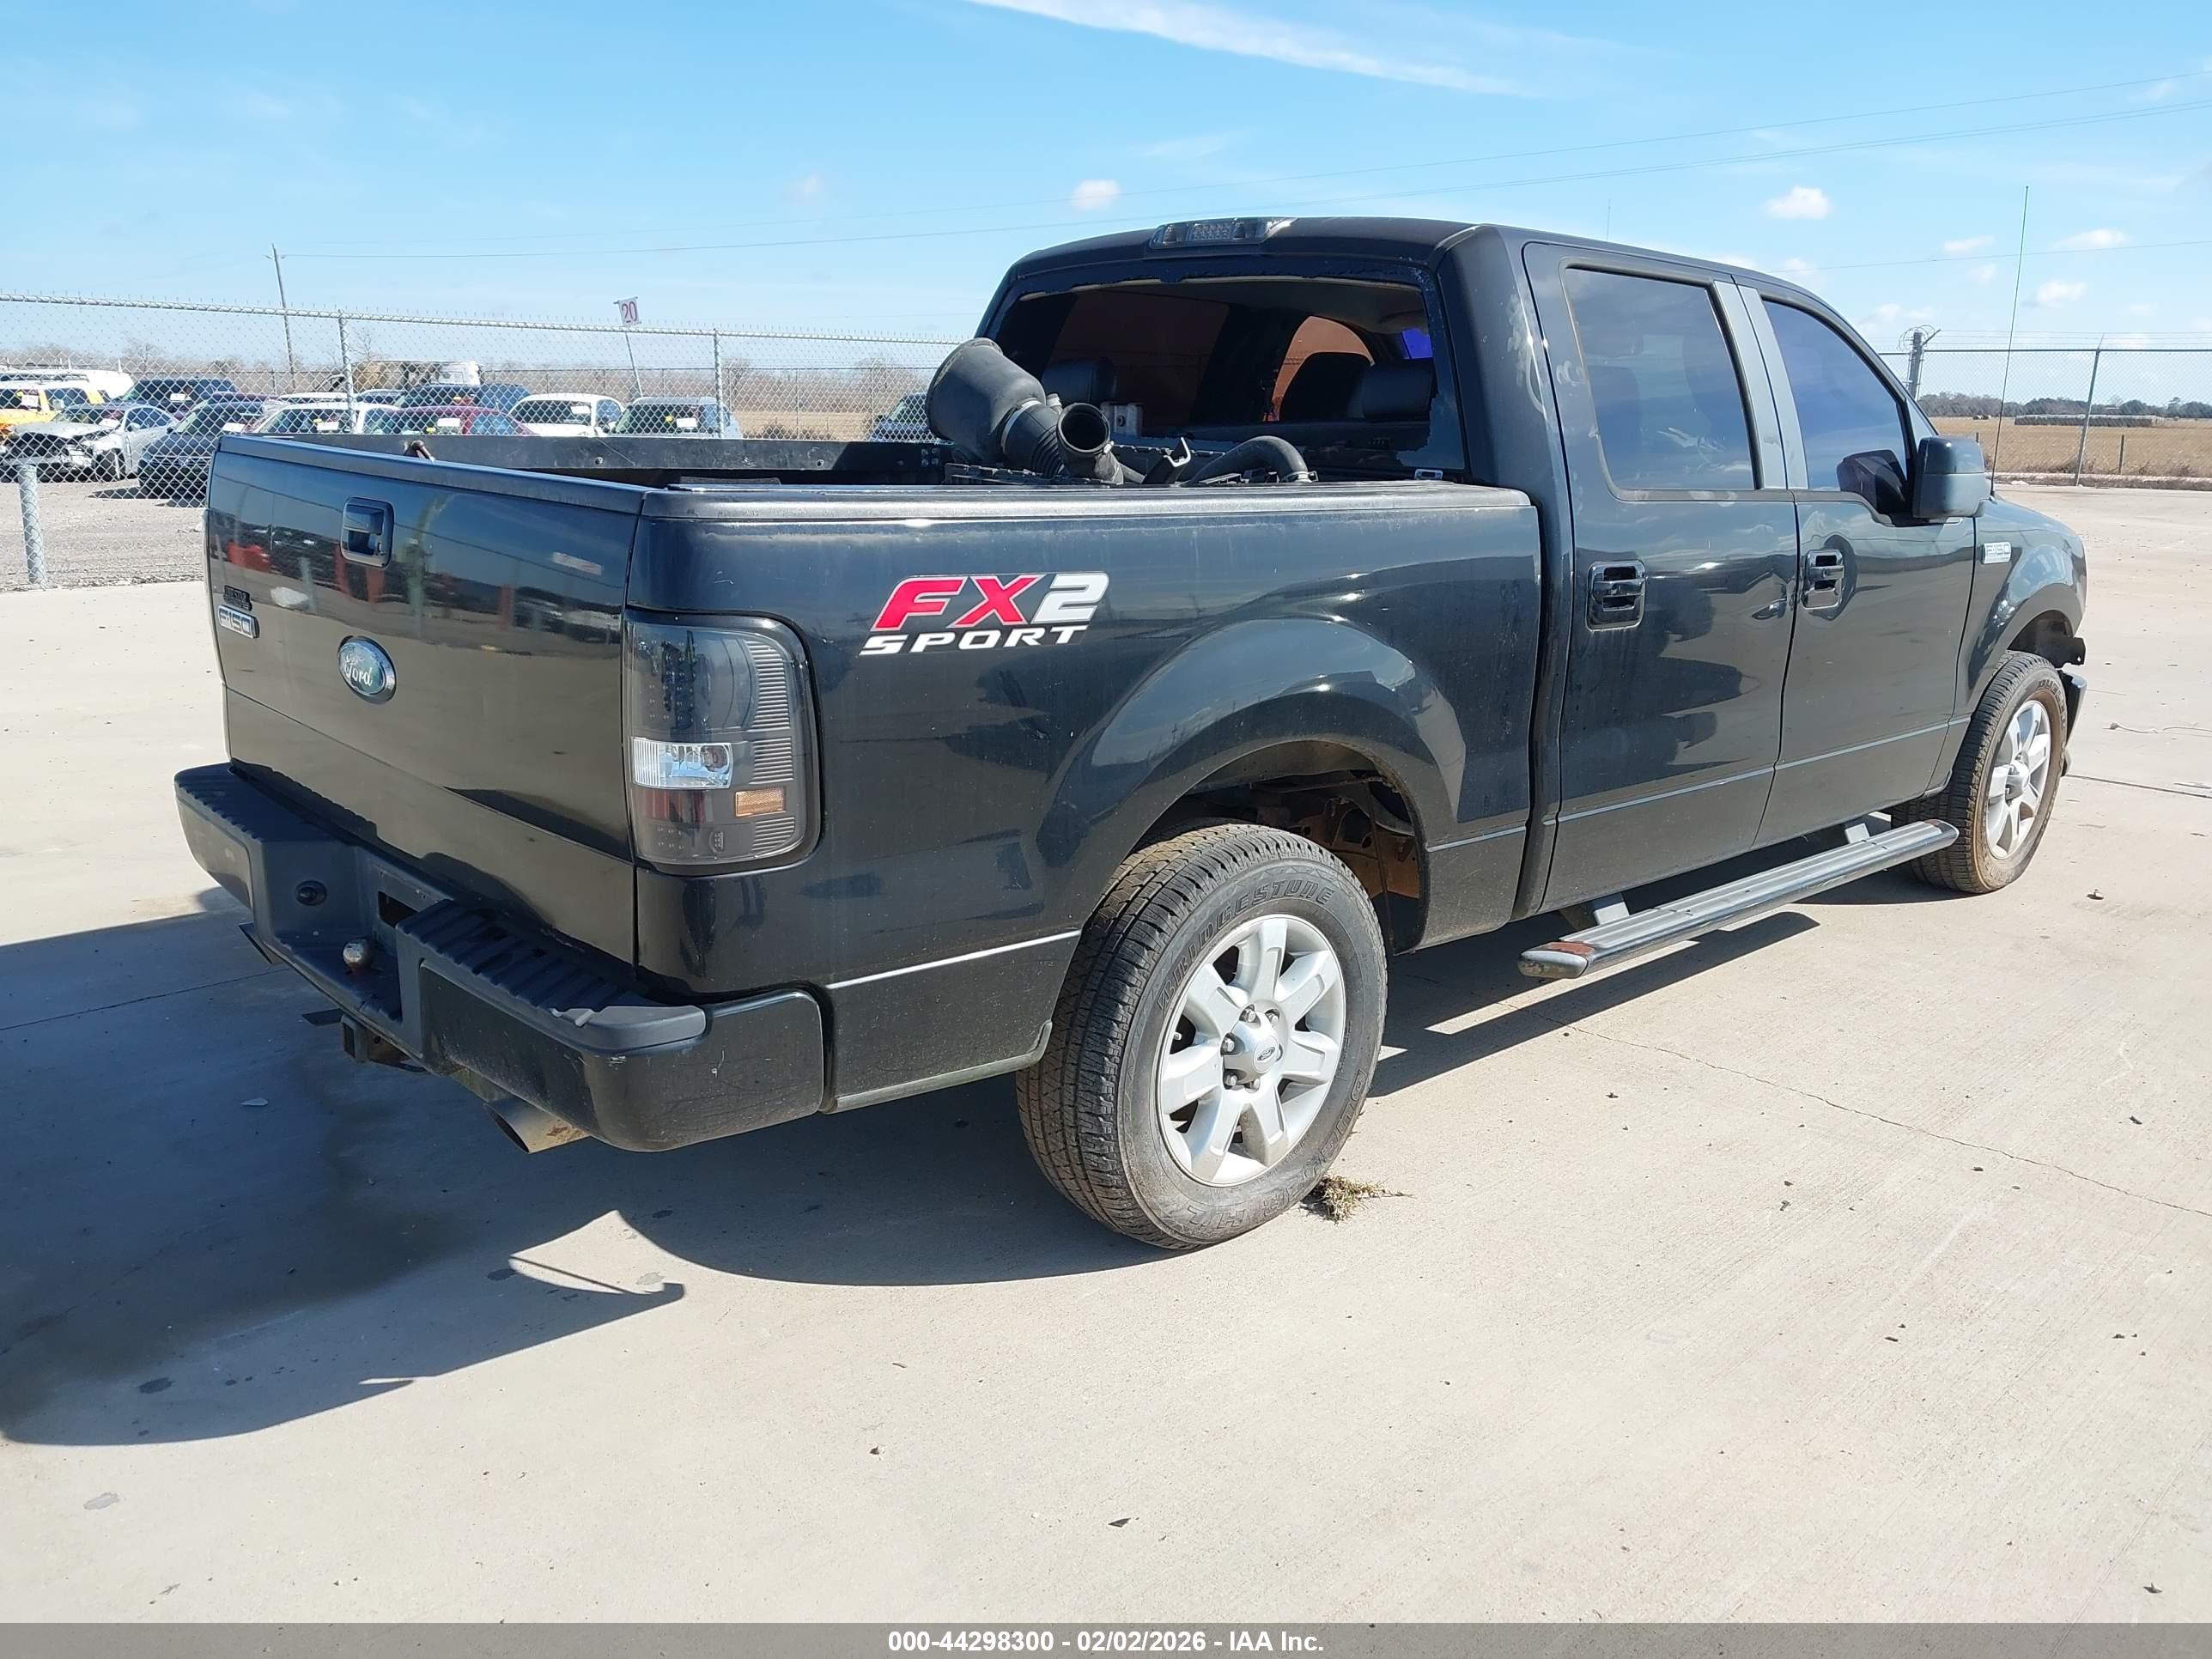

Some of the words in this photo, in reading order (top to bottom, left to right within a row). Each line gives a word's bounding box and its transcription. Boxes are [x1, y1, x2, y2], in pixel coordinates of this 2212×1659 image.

[870, 571, 1110, 632] FX2
[858, 624, 1089, 656] SPORT
[343, 650, 374, 687] Ford
[1155, 878, 1335, 1013] BRIDGESTONE
